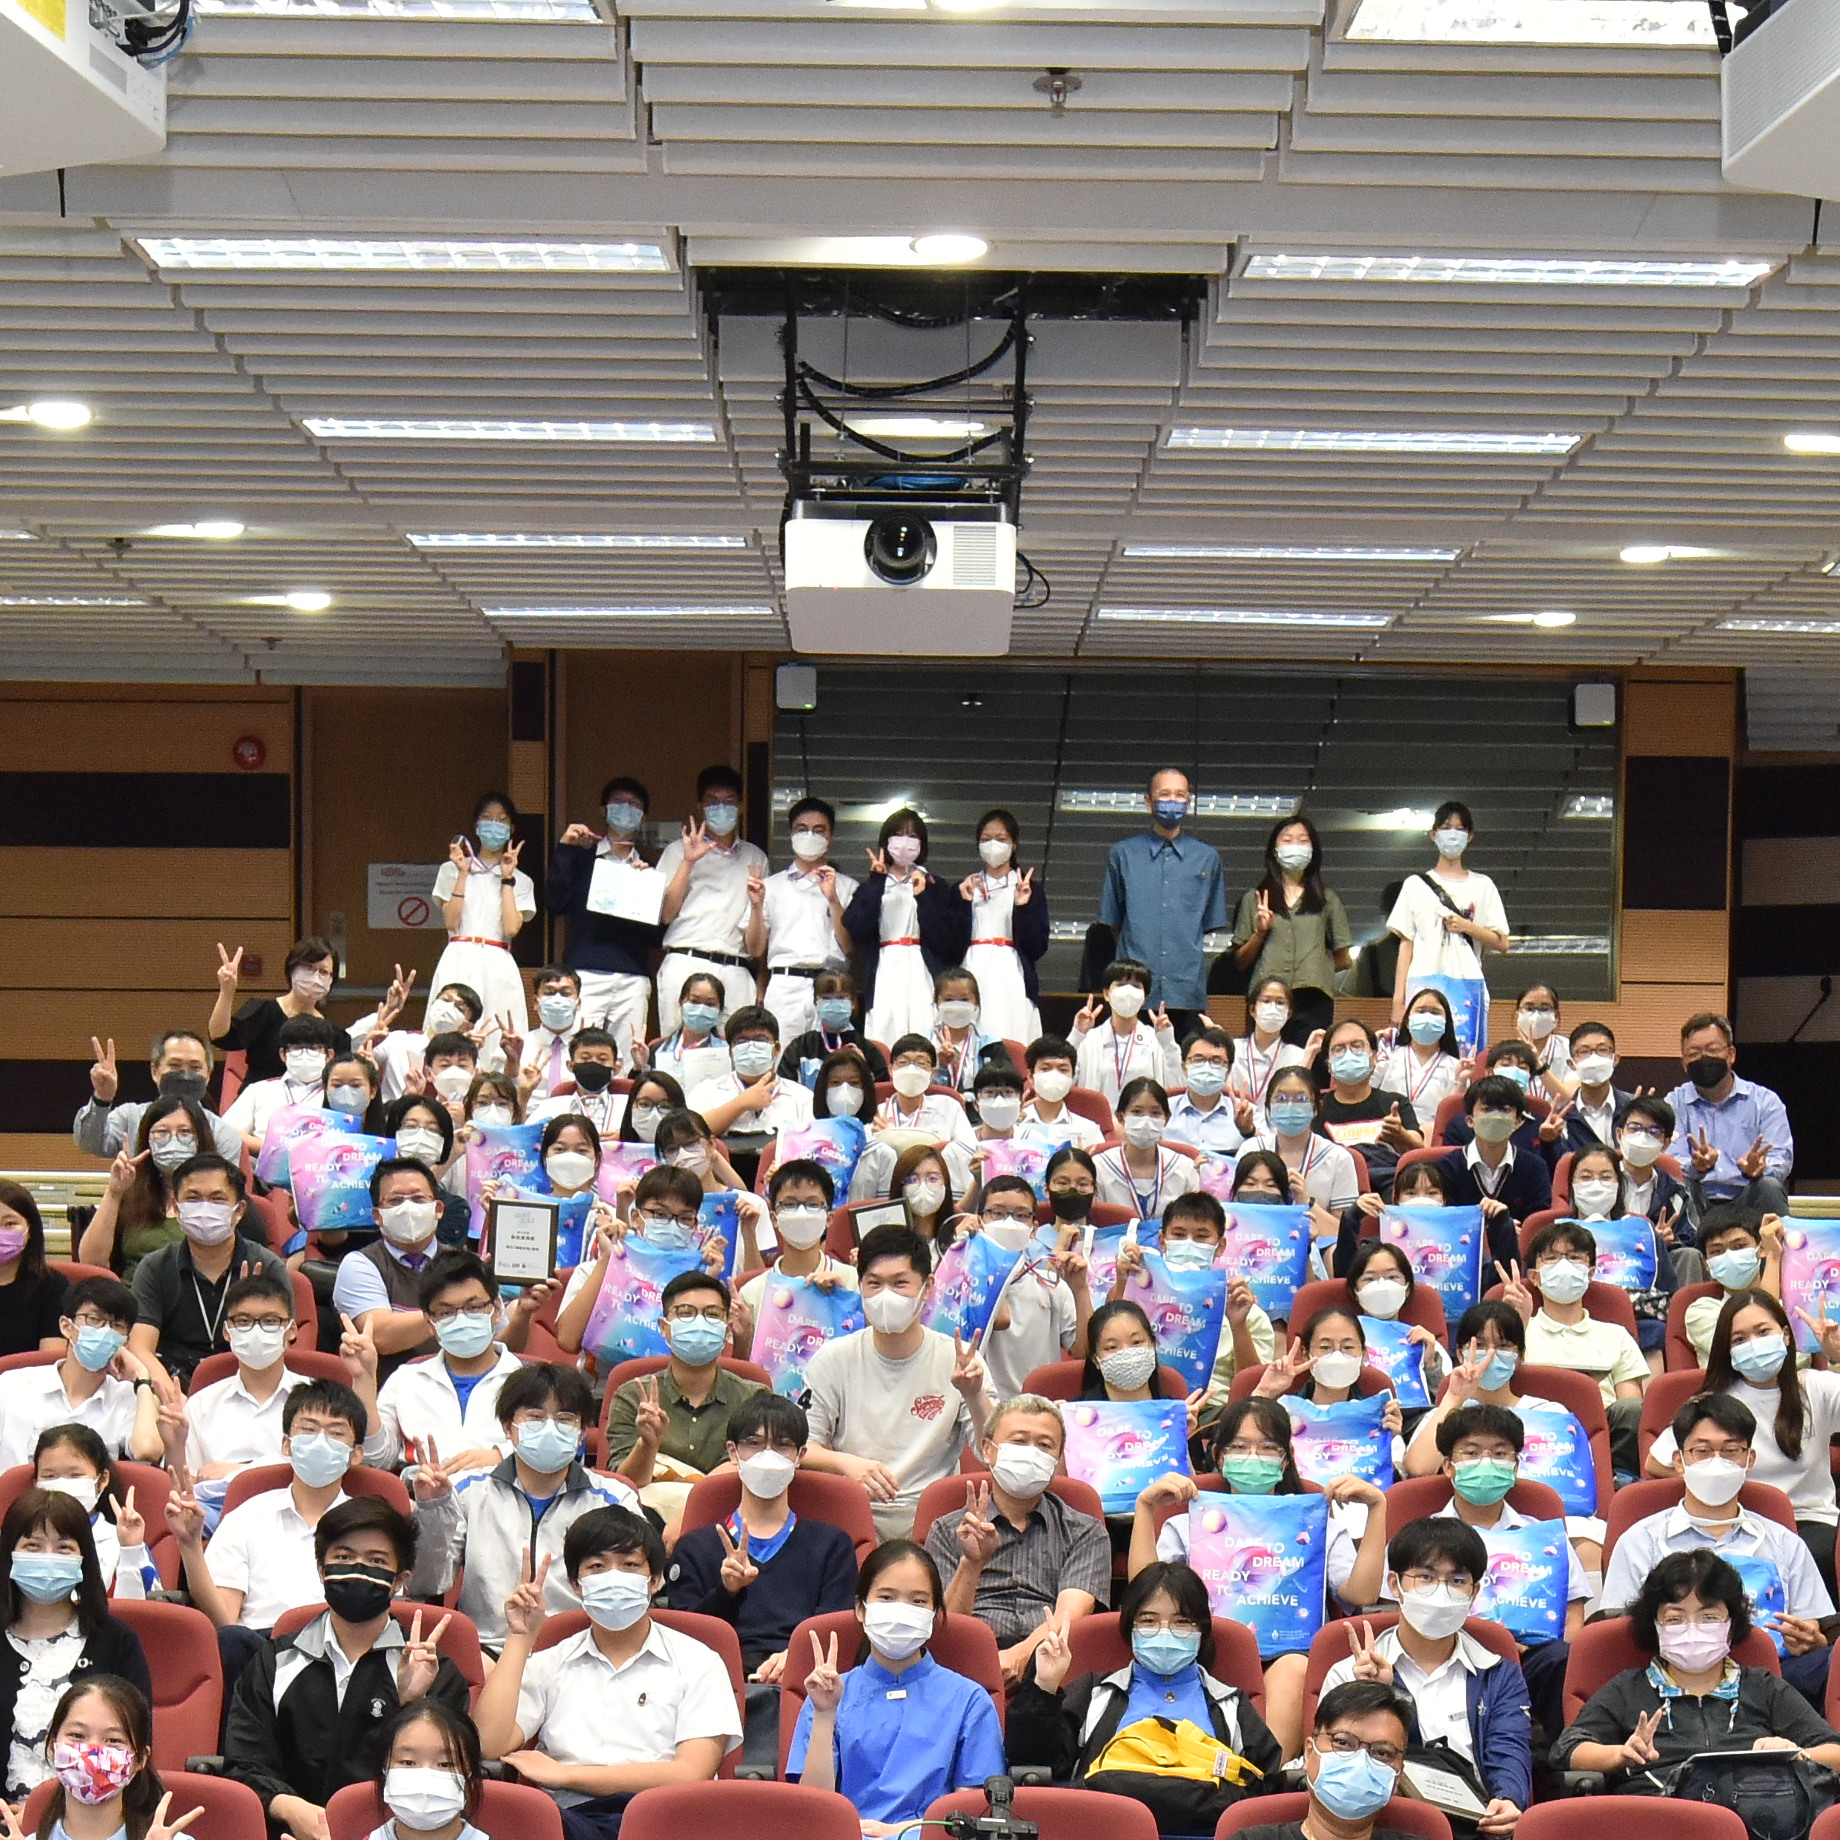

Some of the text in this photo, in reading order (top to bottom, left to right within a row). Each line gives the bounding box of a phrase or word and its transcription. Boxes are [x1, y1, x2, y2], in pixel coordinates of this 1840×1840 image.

[353, 1142, 368, 1151] TO
[343, 1153, 382, 1162] DREAM
[513, 1149, 526, 1157] TO
[504, 1159, 538, 1168] DREAM
[1028, 1155, 1048, 1165] DRE
[305, 1163, 341, 1172] READY
[315, 1174, 328, 1183] TO
[470, 1169, 504, 1179] READY
[331, 1180, 371, 1189] ACHIEV
[1235, 1233, 1281, 1247] DARE TO
[1256, 1248, 1295, 1257] DREAM
[1438, 1243, 1451, 1251] TO
[1428, 1253, 1467, 1262] DREAM
[1806, 1252, 1837, 1261] DARE
[1219, 1257, 1255, 1268] READY
[625, 1263, 651, 1281] DARE
[1229, 1267, 1242, 1276] TO
[1790, 1280, 1829, 1290] READY
[604, 1284, 640, 1303] READY
[642, 1289, 662, 1301] DRE
[1801, 1293, 1815, 1302] TO
[611, 1300, 625, 1311] TO
[1150, 1293, 1193, 1314] DARE TO
[787, 1314, 835, 1337] DARE TO
[1165, 1312, 1206, 1329] DREAM
[765, 1338, 804, 1353] READY
[806, 1335, 828, 1346] DRE
[773, 1352, 787, 1363] TO
[1159, 1346, 1197, 1359] CHIEVE
[1097, 1425, 1152, 1439] DARE TO
[1539, 1431, 1557, 1442] TO
[1529, 1442, 1575, 1453] DREAM
[1224, 1537, 1285, 1554] DARE TO
[1514, 1551, 1532, 1562] TO
[1253, 1557, 1304, 1568] DREAM
[1500, 1562, 1552, 1576] DREAM
[1202, 1570, 1250, 1582] READY
[1216, 1585, 1233, 1596] TO
[1236, 1594, 1298, 1607] ACHIEVE
[1491, 1595, 1547, 1609] ACHIEVE
